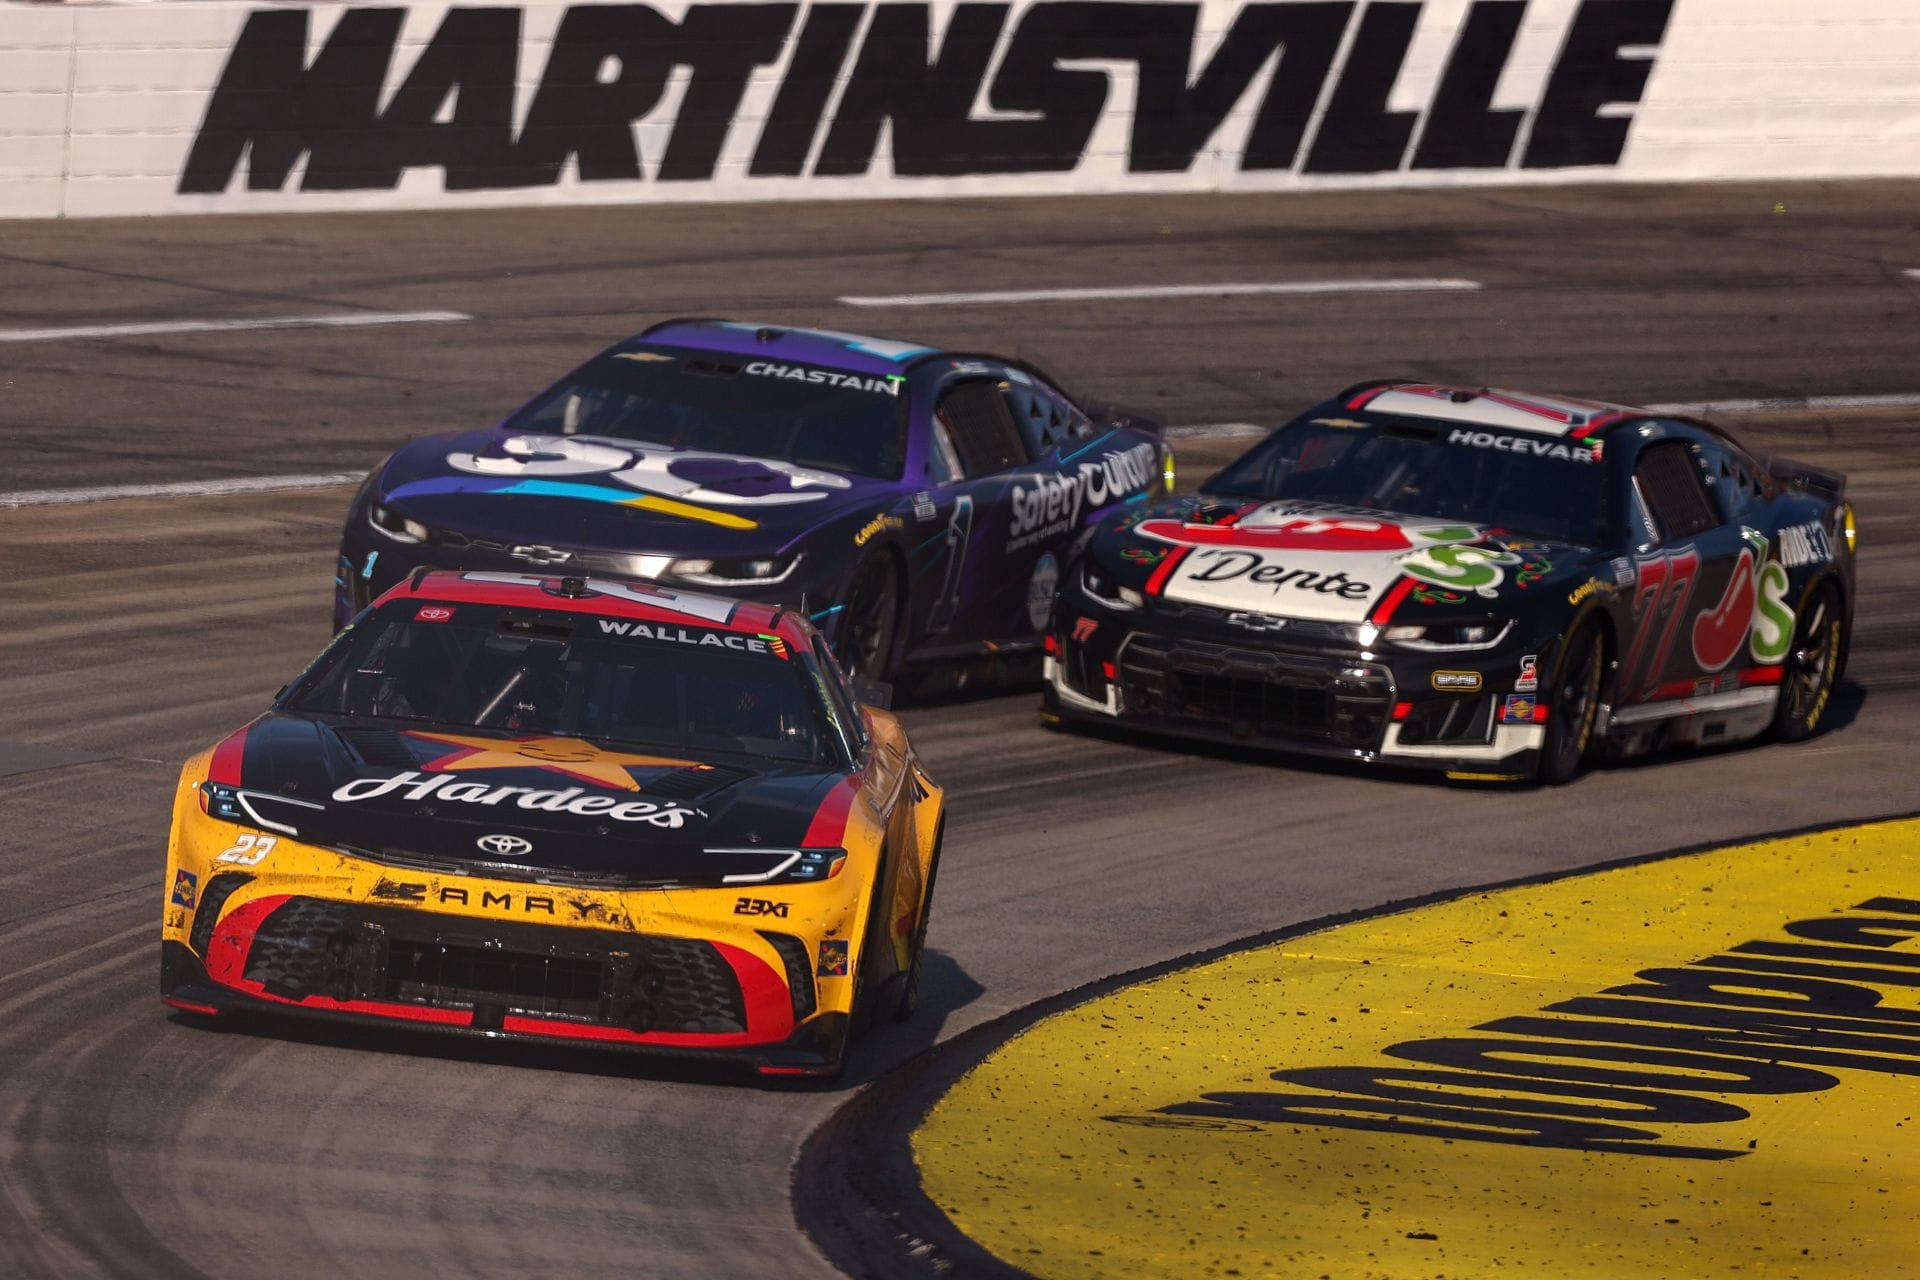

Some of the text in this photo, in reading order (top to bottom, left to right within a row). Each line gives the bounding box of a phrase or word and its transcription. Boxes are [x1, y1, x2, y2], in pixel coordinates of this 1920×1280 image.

[178, 0, 1674, 193] MARTINSVILLE
[745, 361, 900, 396] CHASTAIN
[1447, 428, 1593, 464] HOCEVAR
[361, 550, 379, 579] 1
[598, 619, 768, 655] WALLACE
[1071, 616, 1099, 641] 77
[1619, 543, 1702, 696] 77
[215, 833, 277, 866] 23
